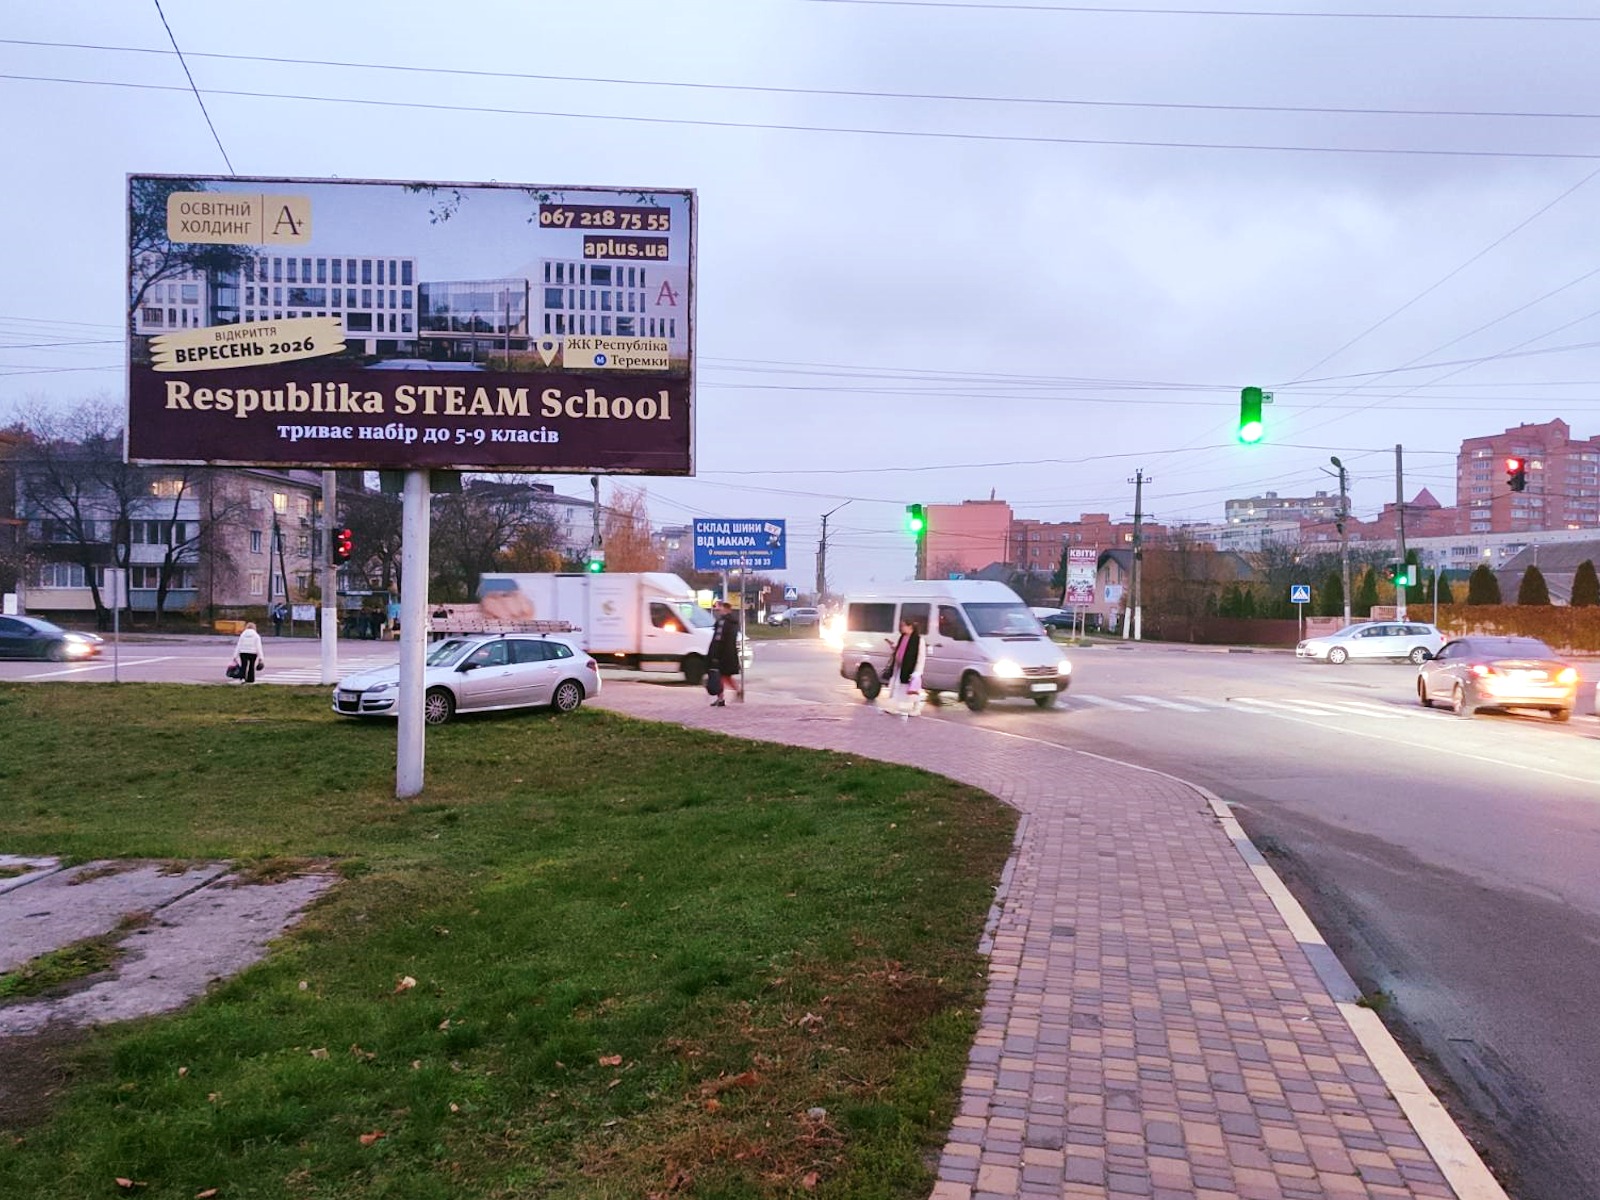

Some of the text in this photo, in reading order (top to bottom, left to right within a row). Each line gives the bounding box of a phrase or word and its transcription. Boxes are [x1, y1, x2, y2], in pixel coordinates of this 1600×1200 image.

[180, 201, 251, 217] ОСВІТНІЙ
[181, 219, 252, 236] ХОЛДИНГ
[540, 208, 669, 231] 067 218 75 55
[584, 239, 668, 259] aplus.ua
[215, 326, 277, 342] ВІДКРИТТЯ
[175, 337, 315, 363] ВЕРЕСЕНЬ 2026
[567, 338, 668, 356] ЖК Республіка
[611, 354, 668, 368] Теремки
[165, 380, 671, 420] Respublika STEAM School
[277, 423, 560, 445] триває набір до 5-9 класів
[696, 522, 731, 535] СКЛАД
[733, 522, 762, 533] ШИНИ
[697, 536, 756, 548] ВІД МАКАРА
[1070, 549, 1096, 557] КВІТИ
